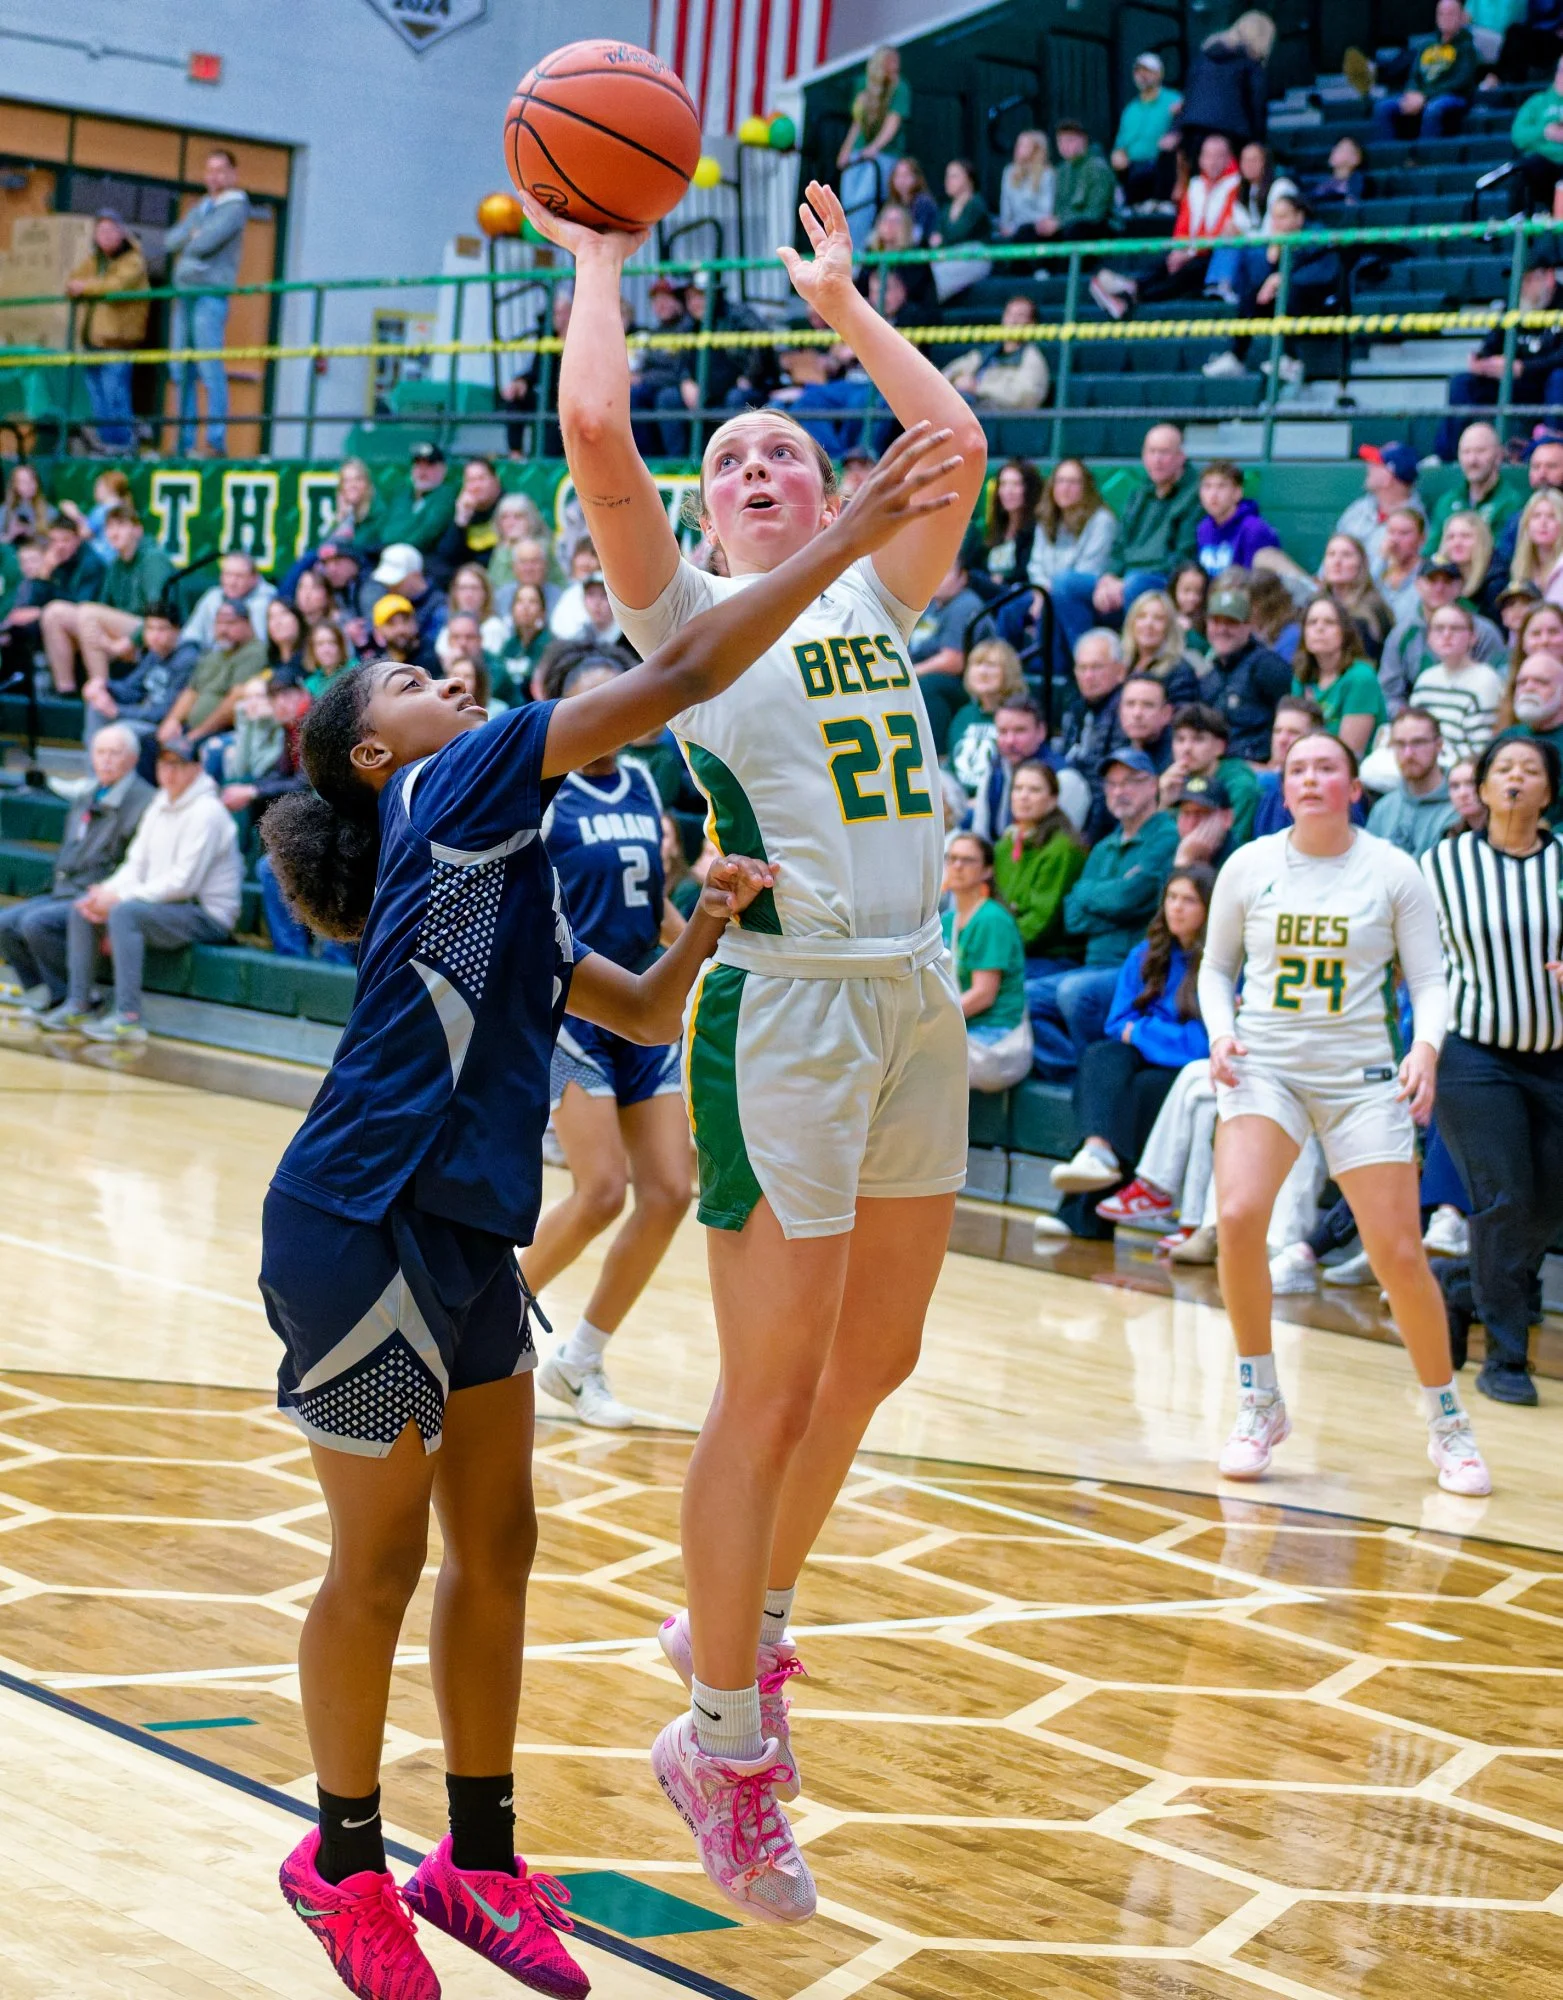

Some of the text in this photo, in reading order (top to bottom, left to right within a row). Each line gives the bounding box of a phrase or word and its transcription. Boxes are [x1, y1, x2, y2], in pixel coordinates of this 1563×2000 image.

[791, 634, 911, 699] BEES
[818, 711, 934, 825] 22
[618, 845, 650, 908] 2
[1275, 912, 1349, 948] BEES
[1273, 955, 1347, 1015] 24
[658, 1774, 669, 1790] BE
[666, 1789, 683, 1813] LIKE
